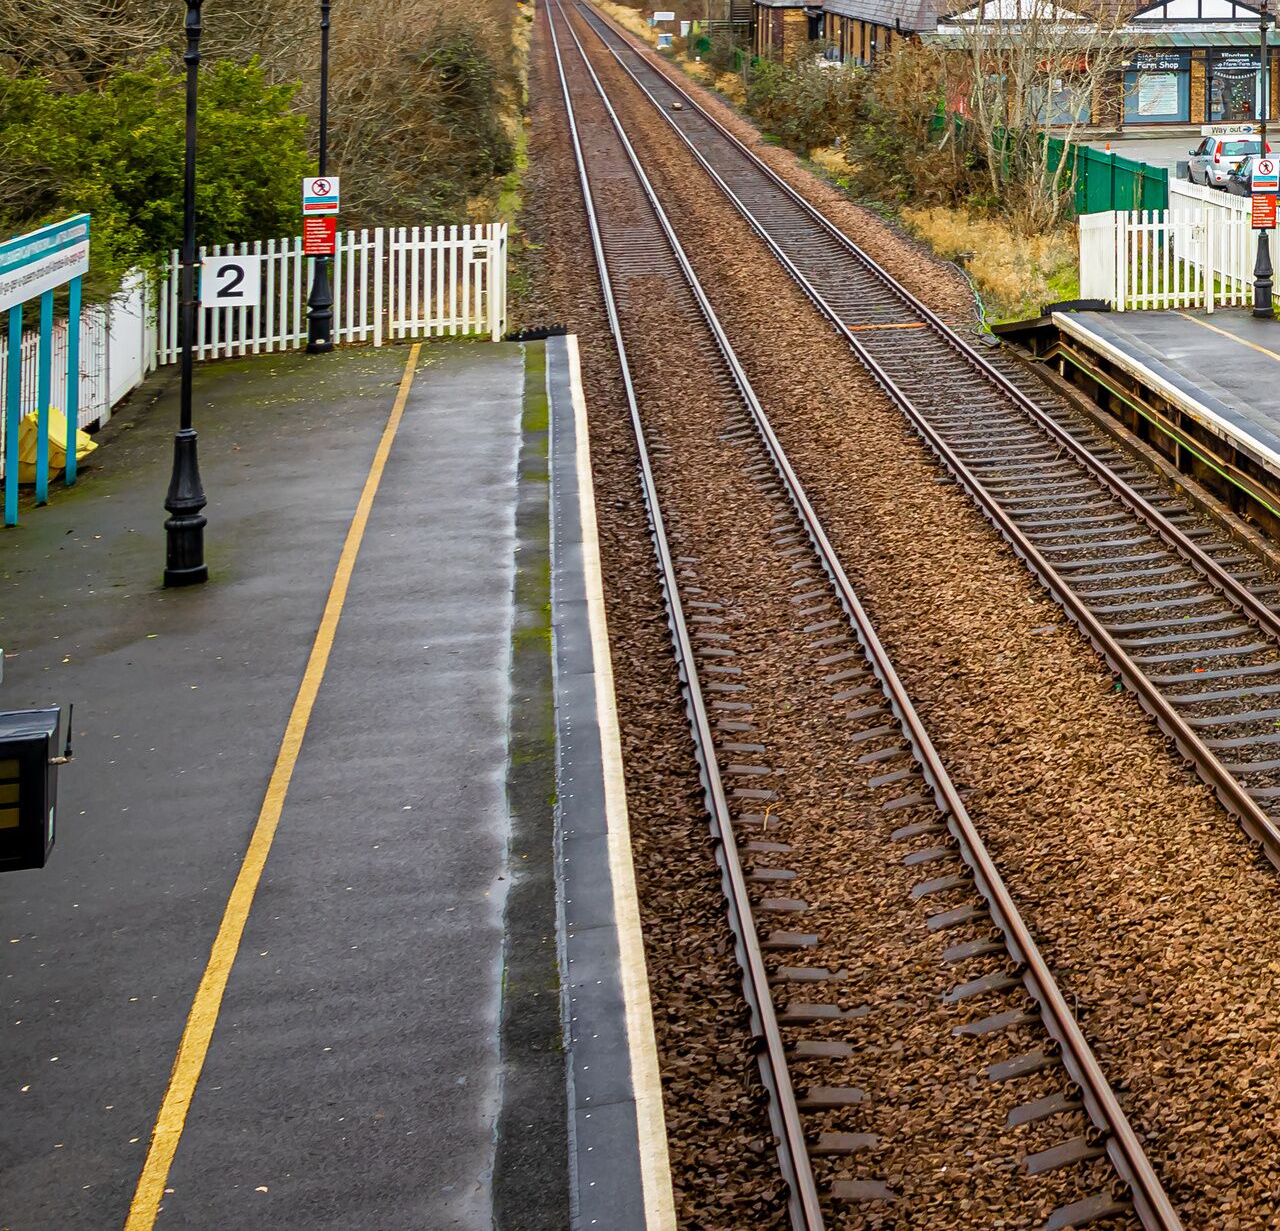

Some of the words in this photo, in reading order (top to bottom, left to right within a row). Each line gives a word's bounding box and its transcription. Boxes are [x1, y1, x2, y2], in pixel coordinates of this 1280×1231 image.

[1137, 61, 1157, 69] Farm
[1159, 61, 1179, 70] Shop
[1211, 125, 1227, 135] Way
[1230, 125, 1243, 133] out
[215, 263, 245, 299] 2
